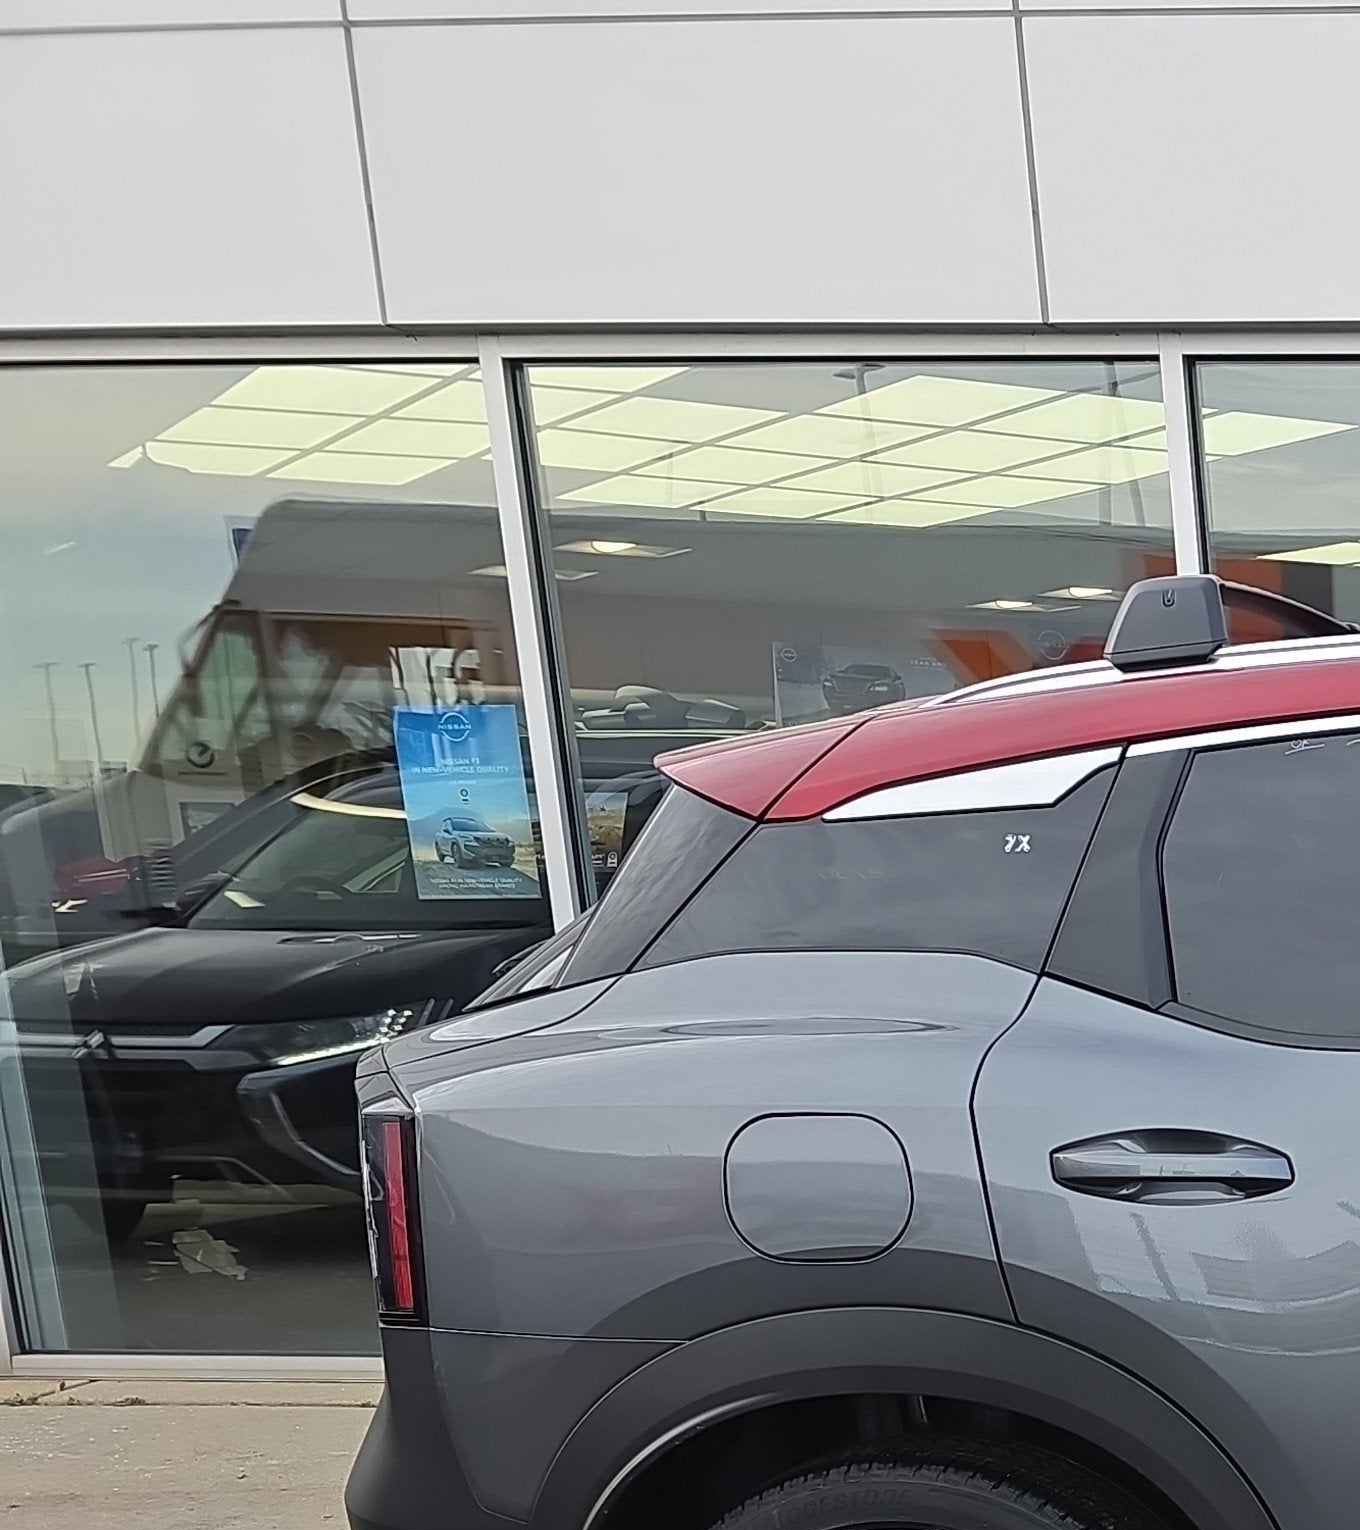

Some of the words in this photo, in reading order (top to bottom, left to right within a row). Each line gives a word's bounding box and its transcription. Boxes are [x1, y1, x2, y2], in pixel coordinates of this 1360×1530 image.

[437, 723, 472, 731] NISSAN
[441, 758, 470, 766] NISSAN
[476, 765, 509, 773] QUALITY
